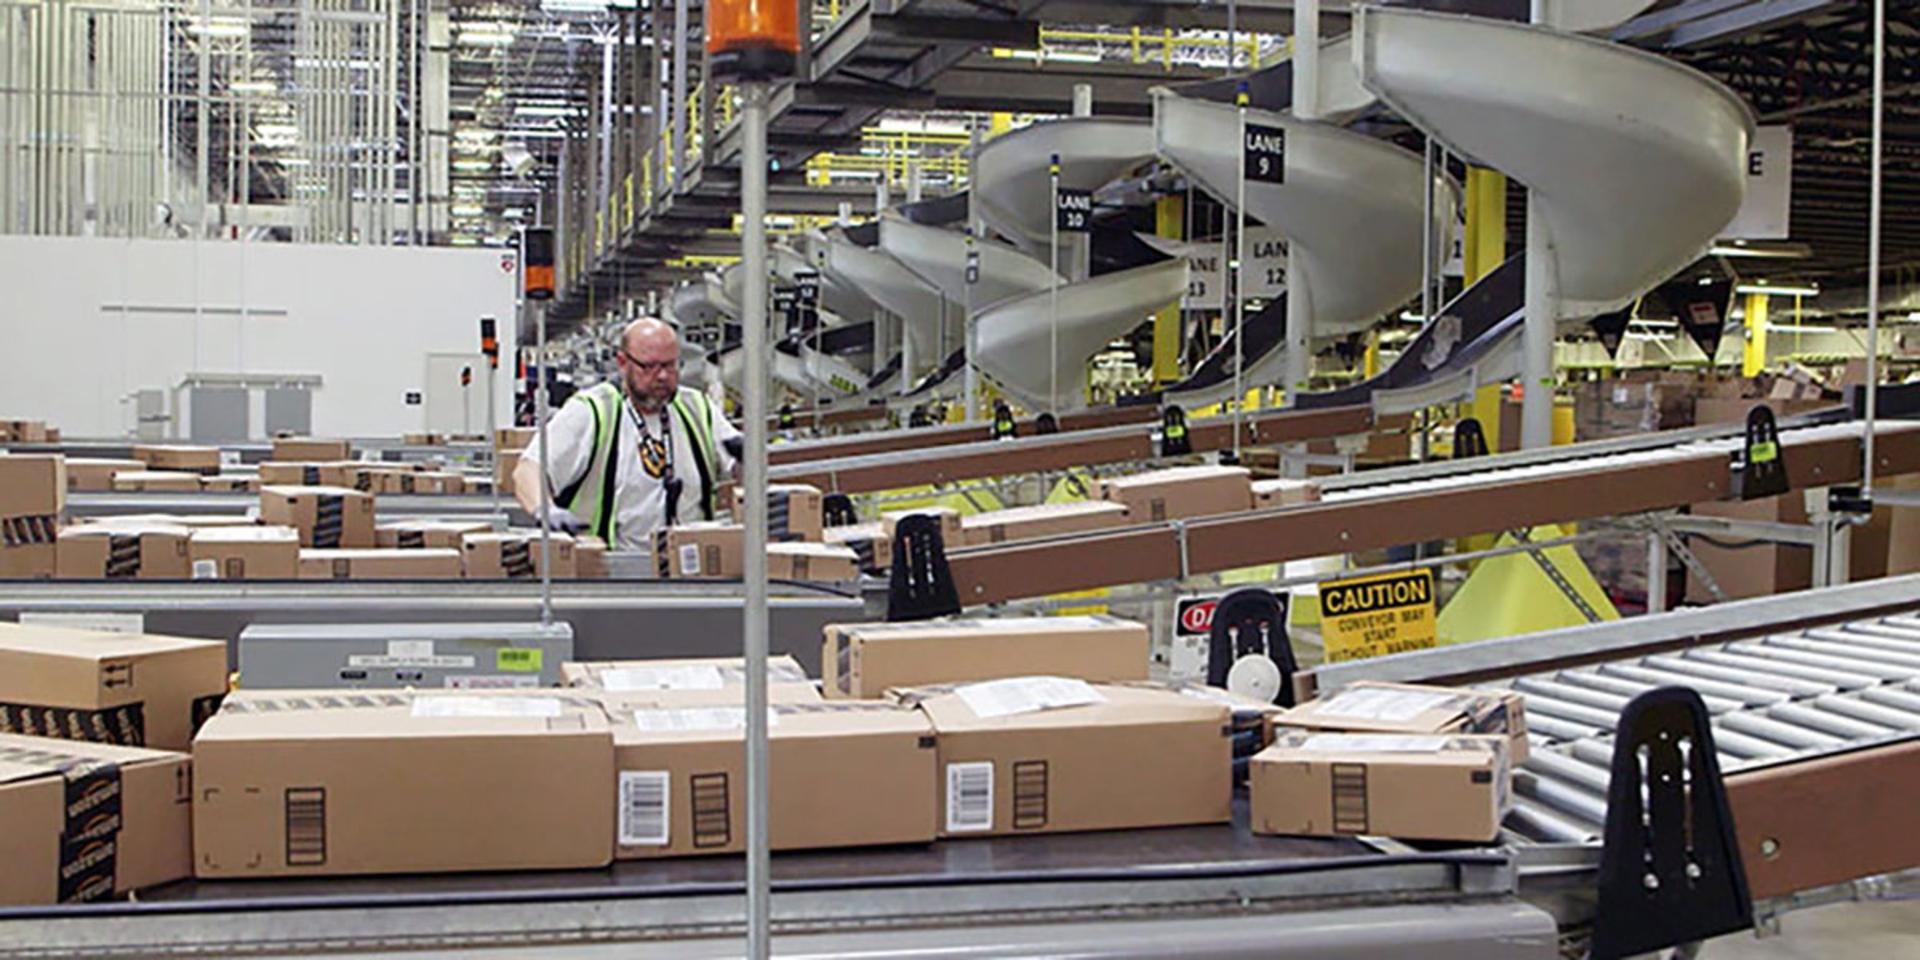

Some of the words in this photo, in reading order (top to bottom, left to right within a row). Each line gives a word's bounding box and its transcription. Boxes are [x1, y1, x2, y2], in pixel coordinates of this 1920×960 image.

[1247, 133, 1282, 154] LANE
[1259, 157, 1270, 175] 9
[1749, 152, 1764, 176] E
[1058, 194, 1090, 210] LANE
[1068, 212, 1084, 227] 10
[1254, 241, 1288, 258] LAN
[1453, 240, 1461, 258] 1
[1190, 257, 1217, 272] ANE
[1267, 267, 1285, 285] 12
[1189, 281, 1205, 297] 13
[1326, 579, 1426, 613] CAUTION
[1339, 612, 1395, 632] CONVEYOR
[1401, 609, 1425, 622] MAY
[1363, 627, 1397, 643] START
